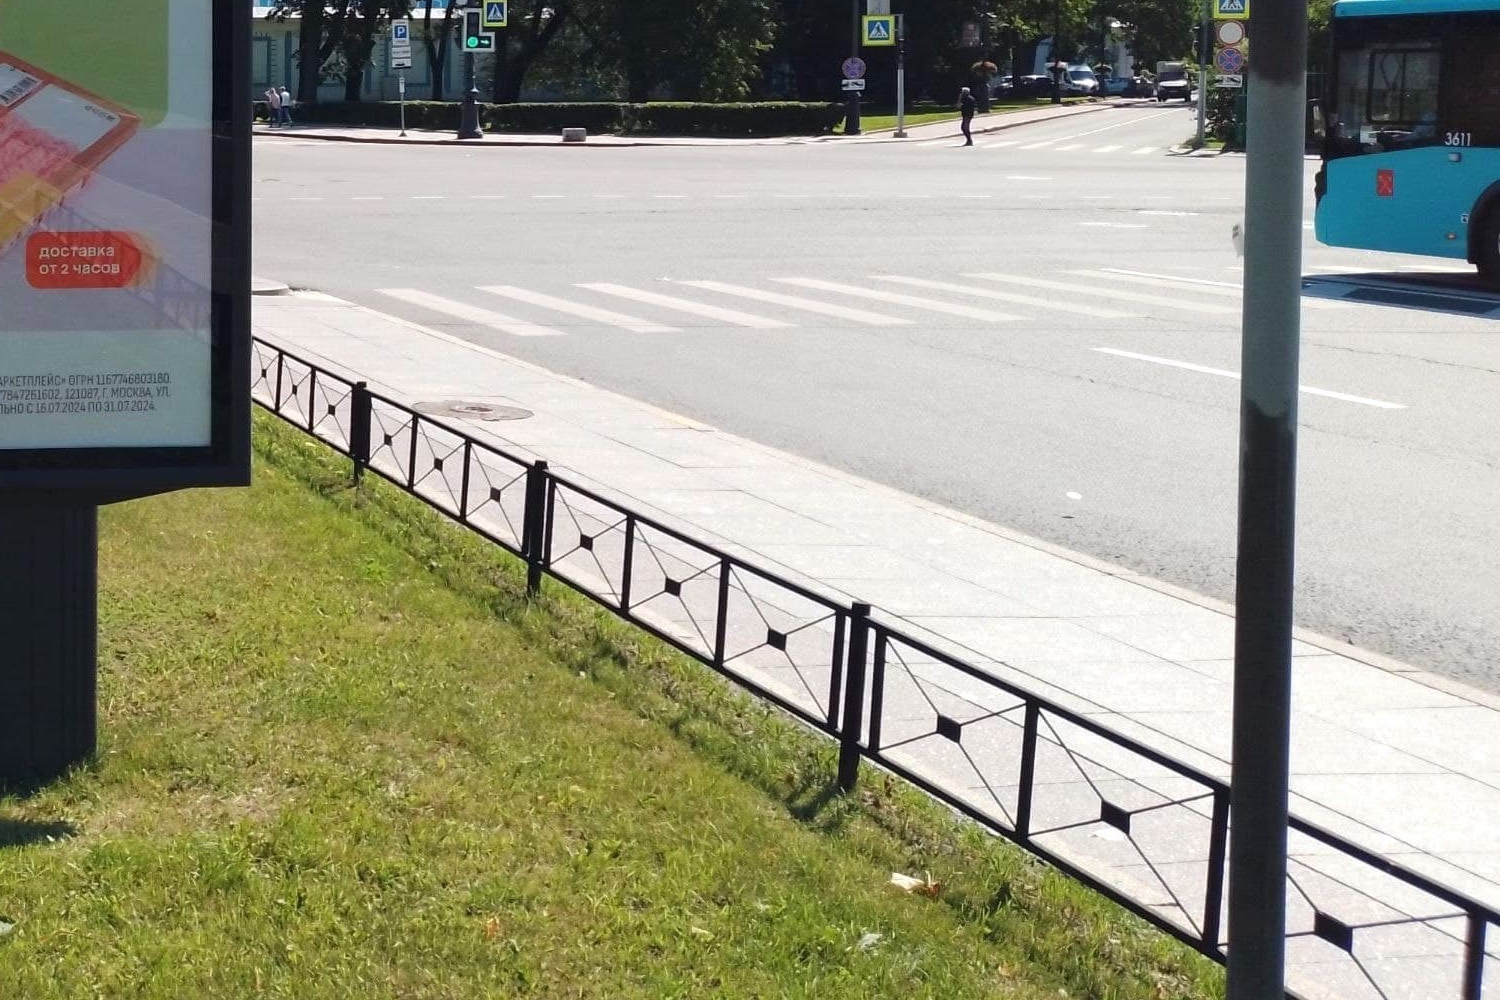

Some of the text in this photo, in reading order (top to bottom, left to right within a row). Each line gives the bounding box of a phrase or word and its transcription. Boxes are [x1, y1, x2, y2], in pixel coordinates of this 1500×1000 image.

[397, 26, 405, 37] P
[1444, 132, 1472, 147] 3611
[39, 246, 115, 259] доставка
[39, 263, 121, 275] от 2 часов
[68, 374, 94, 386] ОГРН
[26, 403, 33, 414] С
[36, 401, 86, 414] 16.07.2024
[88, 401, 101, 413] ПО
